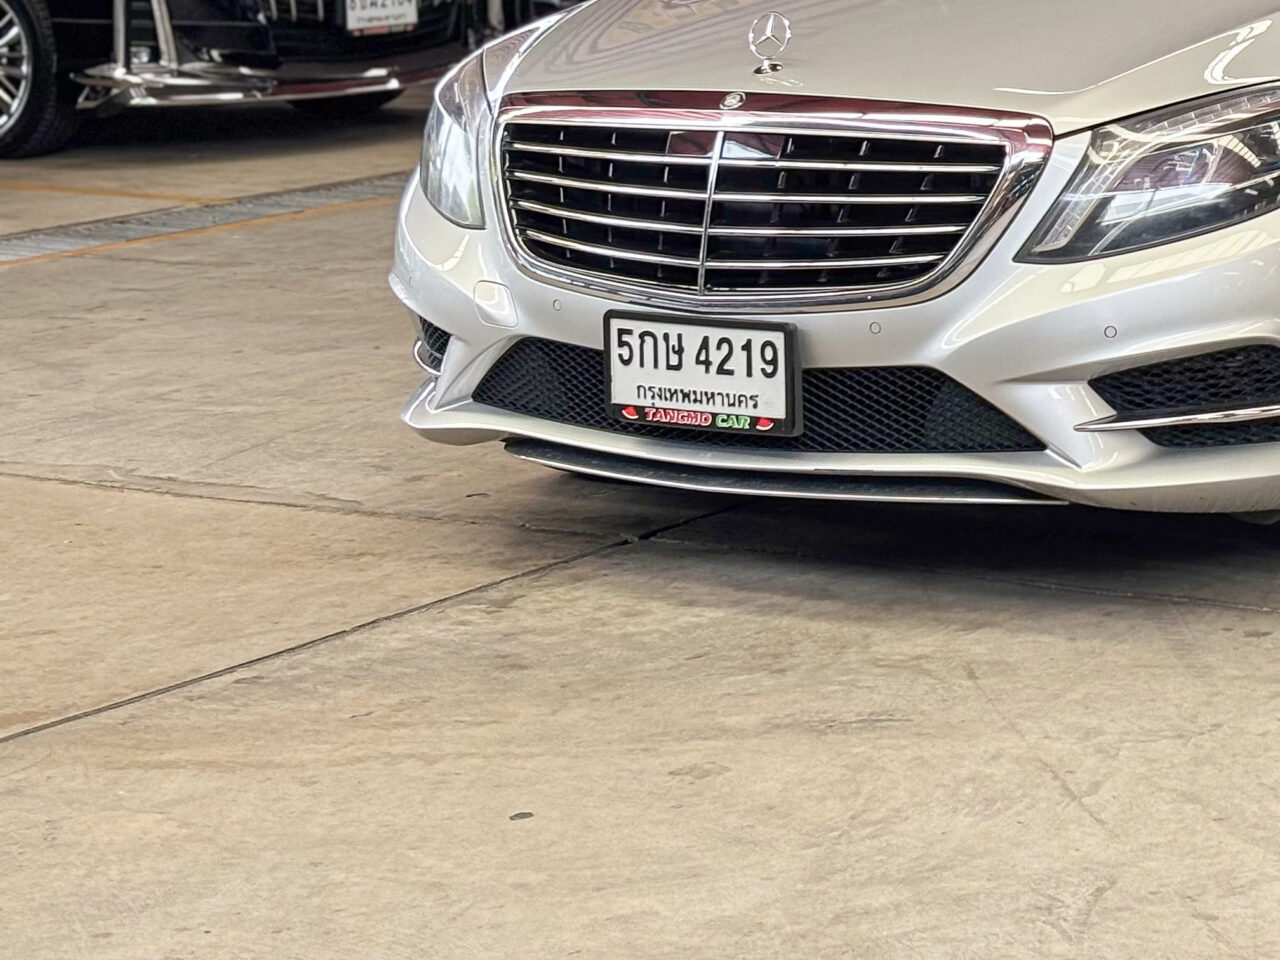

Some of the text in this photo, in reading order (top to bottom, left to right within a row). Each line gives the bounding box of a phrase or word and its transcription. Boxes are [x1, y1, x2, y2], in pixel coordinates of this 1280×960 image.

[617, 327, 779, 379] 5กษ 4219
[636, 384, 759, 410] กรุงเทพมหานคร
[644, 407, 751, 430] TANGMO CAR
